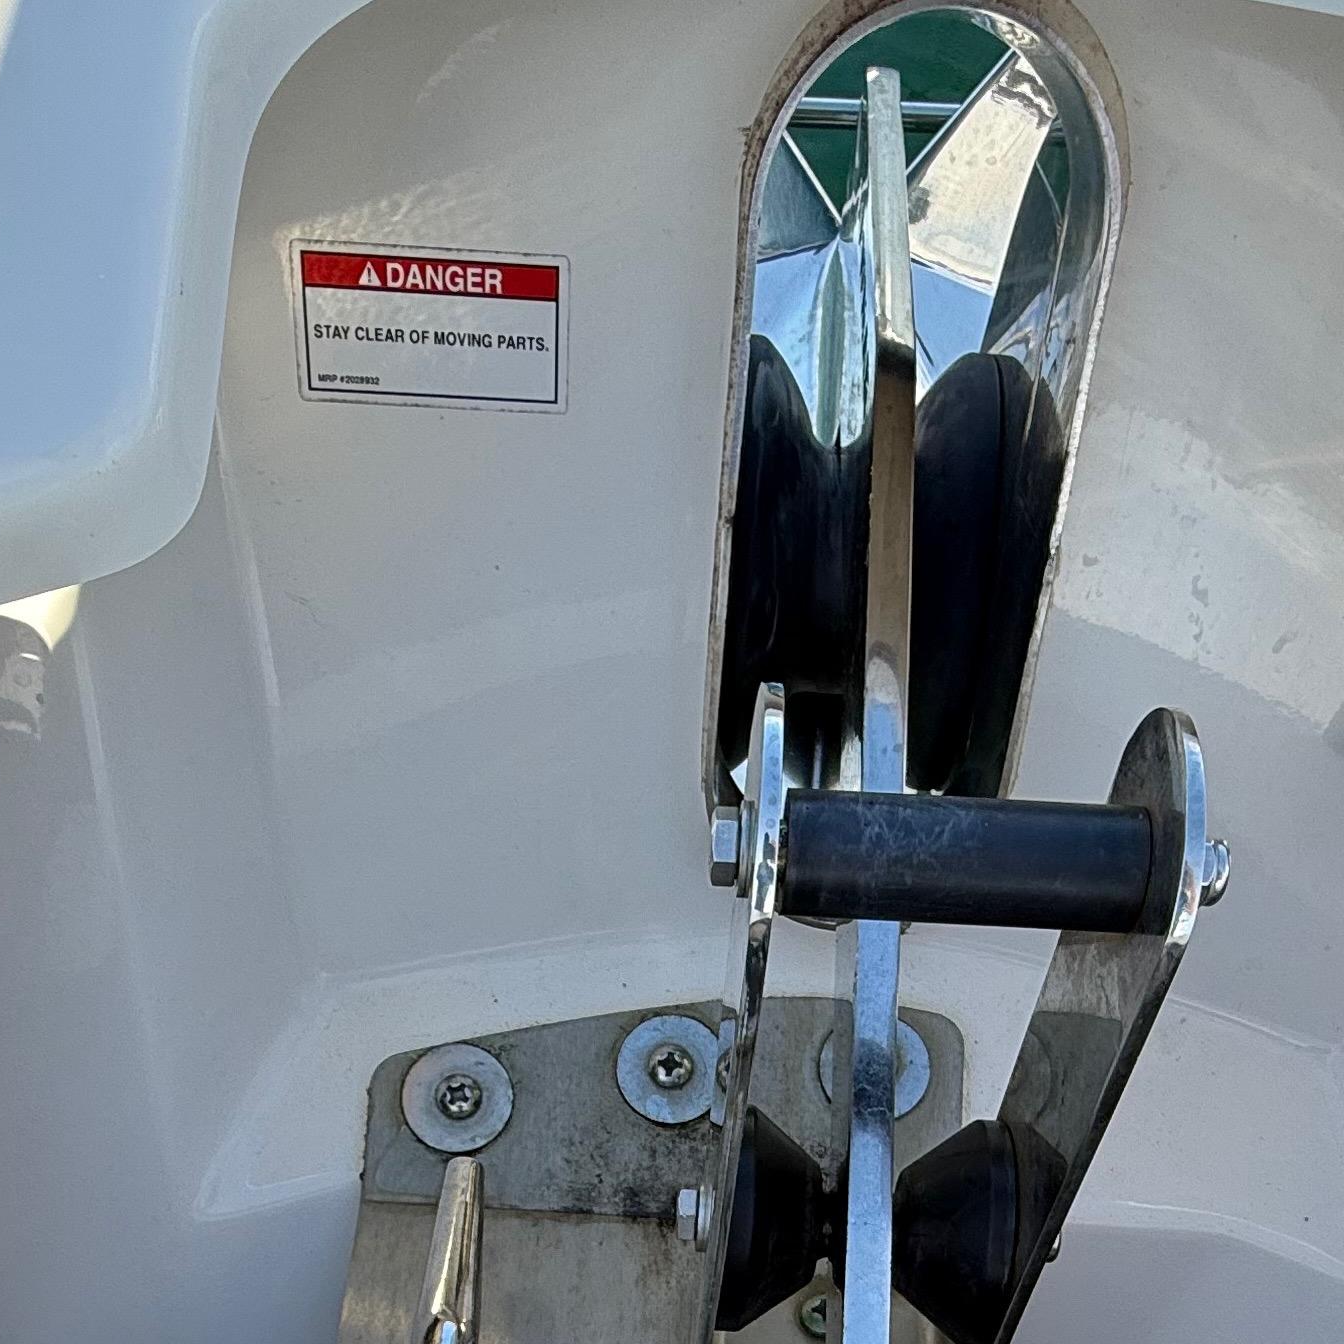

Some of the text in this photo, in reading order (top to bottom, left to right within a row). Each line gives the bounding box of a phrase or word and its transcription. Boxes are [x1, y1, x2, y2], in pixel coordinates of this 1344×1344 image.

[386, 262, 503, 294] DANGER
[314, 324, 549, 352] STAY CLEAR OF MOVING PARTS.
